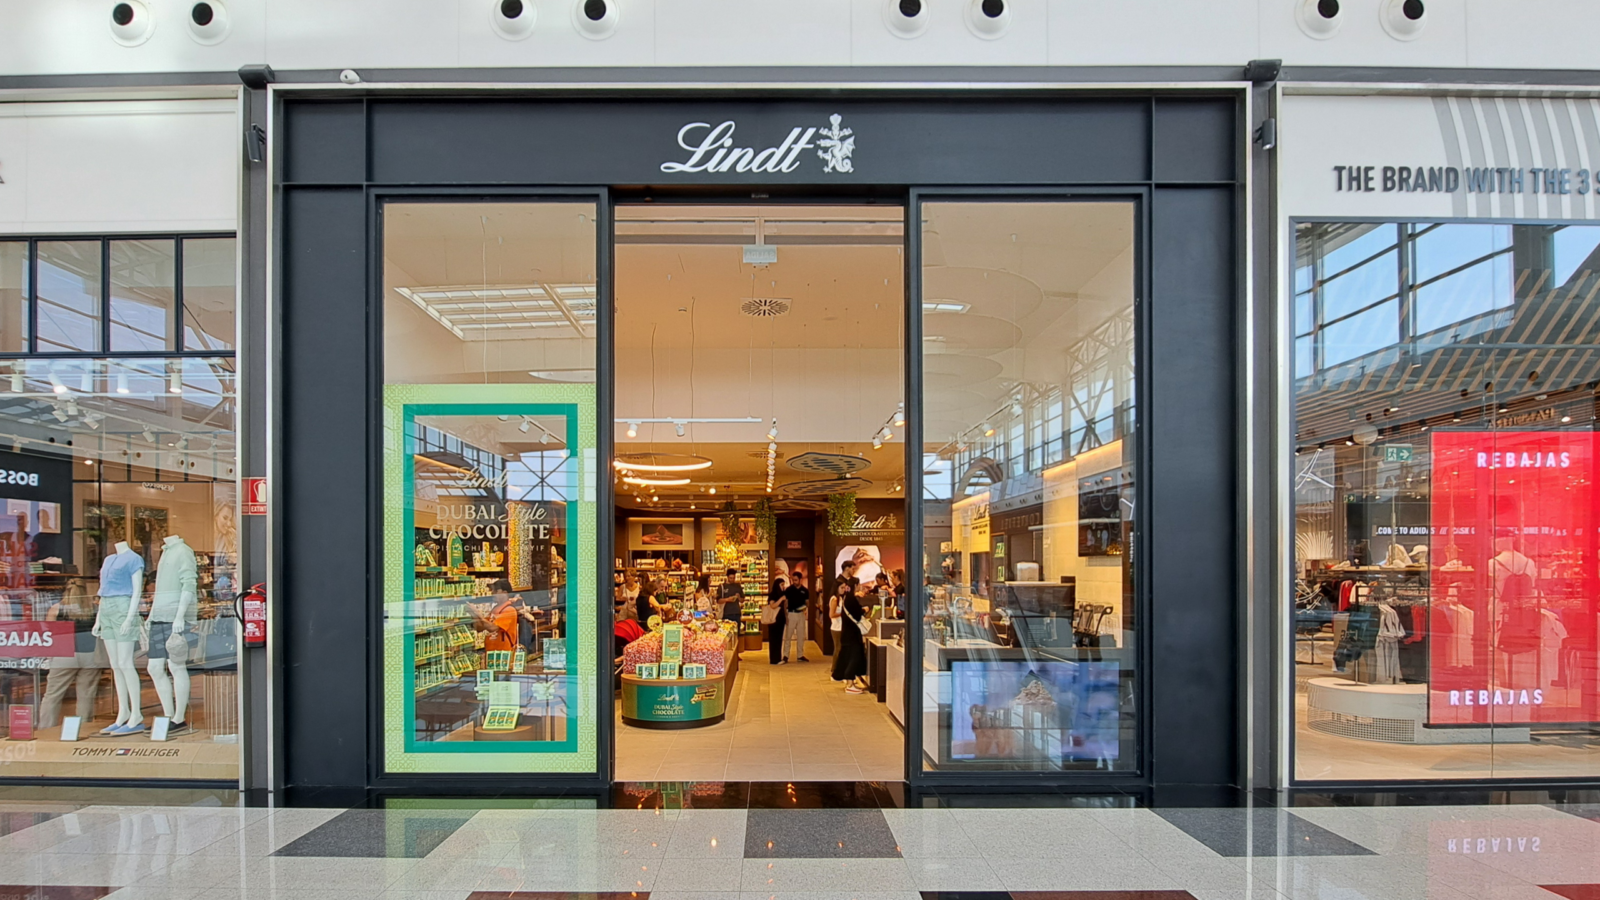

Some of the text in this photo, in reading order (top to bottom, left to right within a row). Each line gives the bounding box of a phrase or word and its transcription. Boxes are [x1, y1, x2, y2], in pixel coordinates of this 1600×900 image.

[660, 120, 817, 173] Lindt
[1333, 165, 1375, 193] THE
[1381, 165, 1459, 193] BRAND
[1465, 167, 1524, 194] WITH
[1531, 167, 1571, 194] THE
[1578, 168, 1590, 195] 3
[1477, 452, 1570, 468] REBAJAS
[437, 502, 547, 522] DUBAI Style
[852, 514, 887, 528] Lindt
[429, 524, 550, 540] CHOCOLTE
[0, 631, 53, 647] BAJAS
[20, 658, 46, 669] 50%
[1450, 689, 1543, 706] REBAJAS
[72, 747, 180, 758] TOMMY HILFIGER
